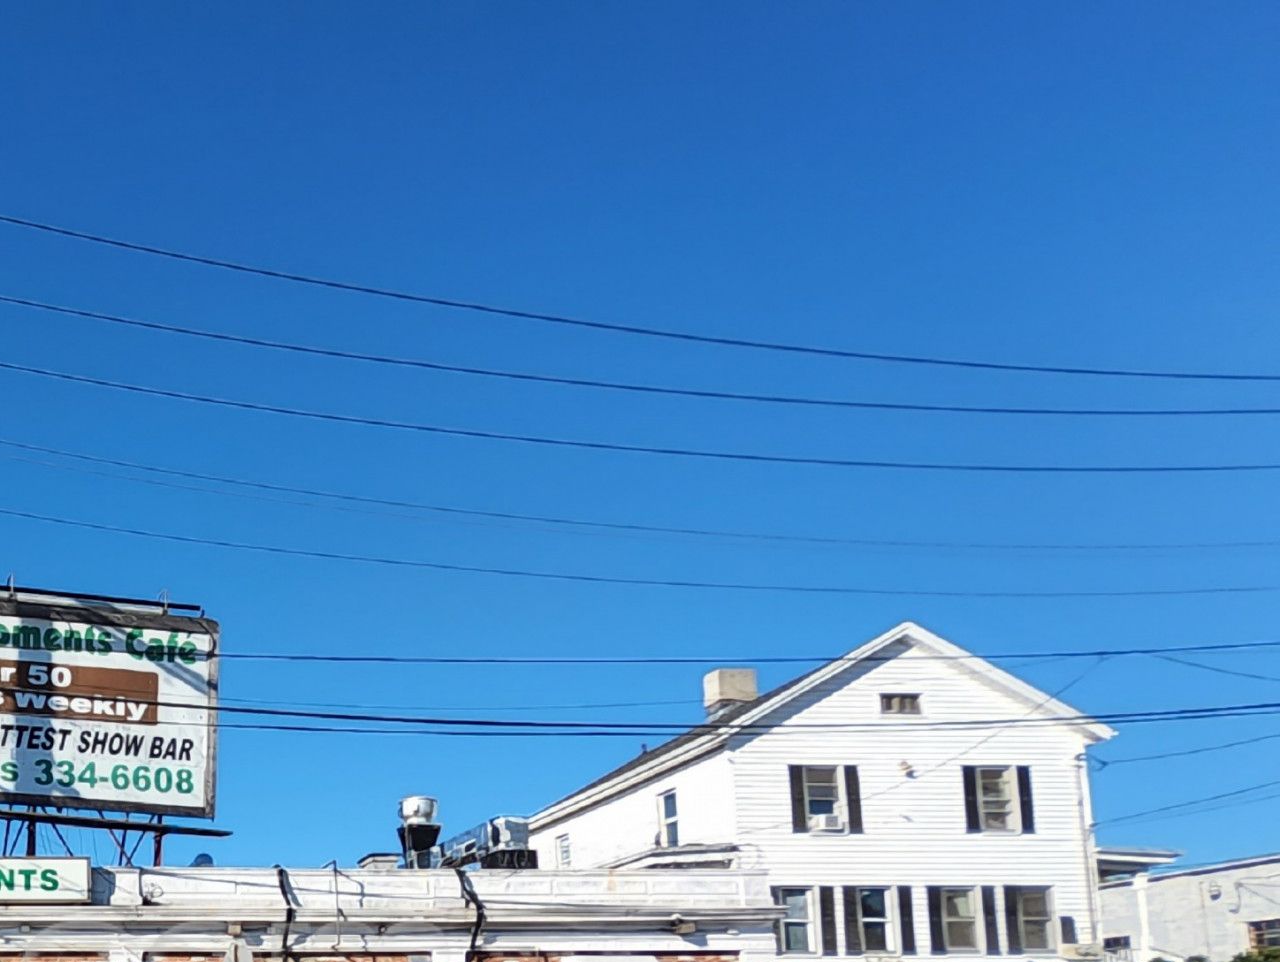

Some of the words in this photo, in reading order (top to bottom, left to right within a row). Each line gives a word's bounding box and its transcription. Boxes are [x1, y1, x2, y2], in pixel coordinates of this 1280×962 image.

[27, 660, 73, 688] 50
[77, 730, 145, 758] SHOW
[149, 736, 195, 761] BAR
[34, 758, 195, 794] 334-6608
